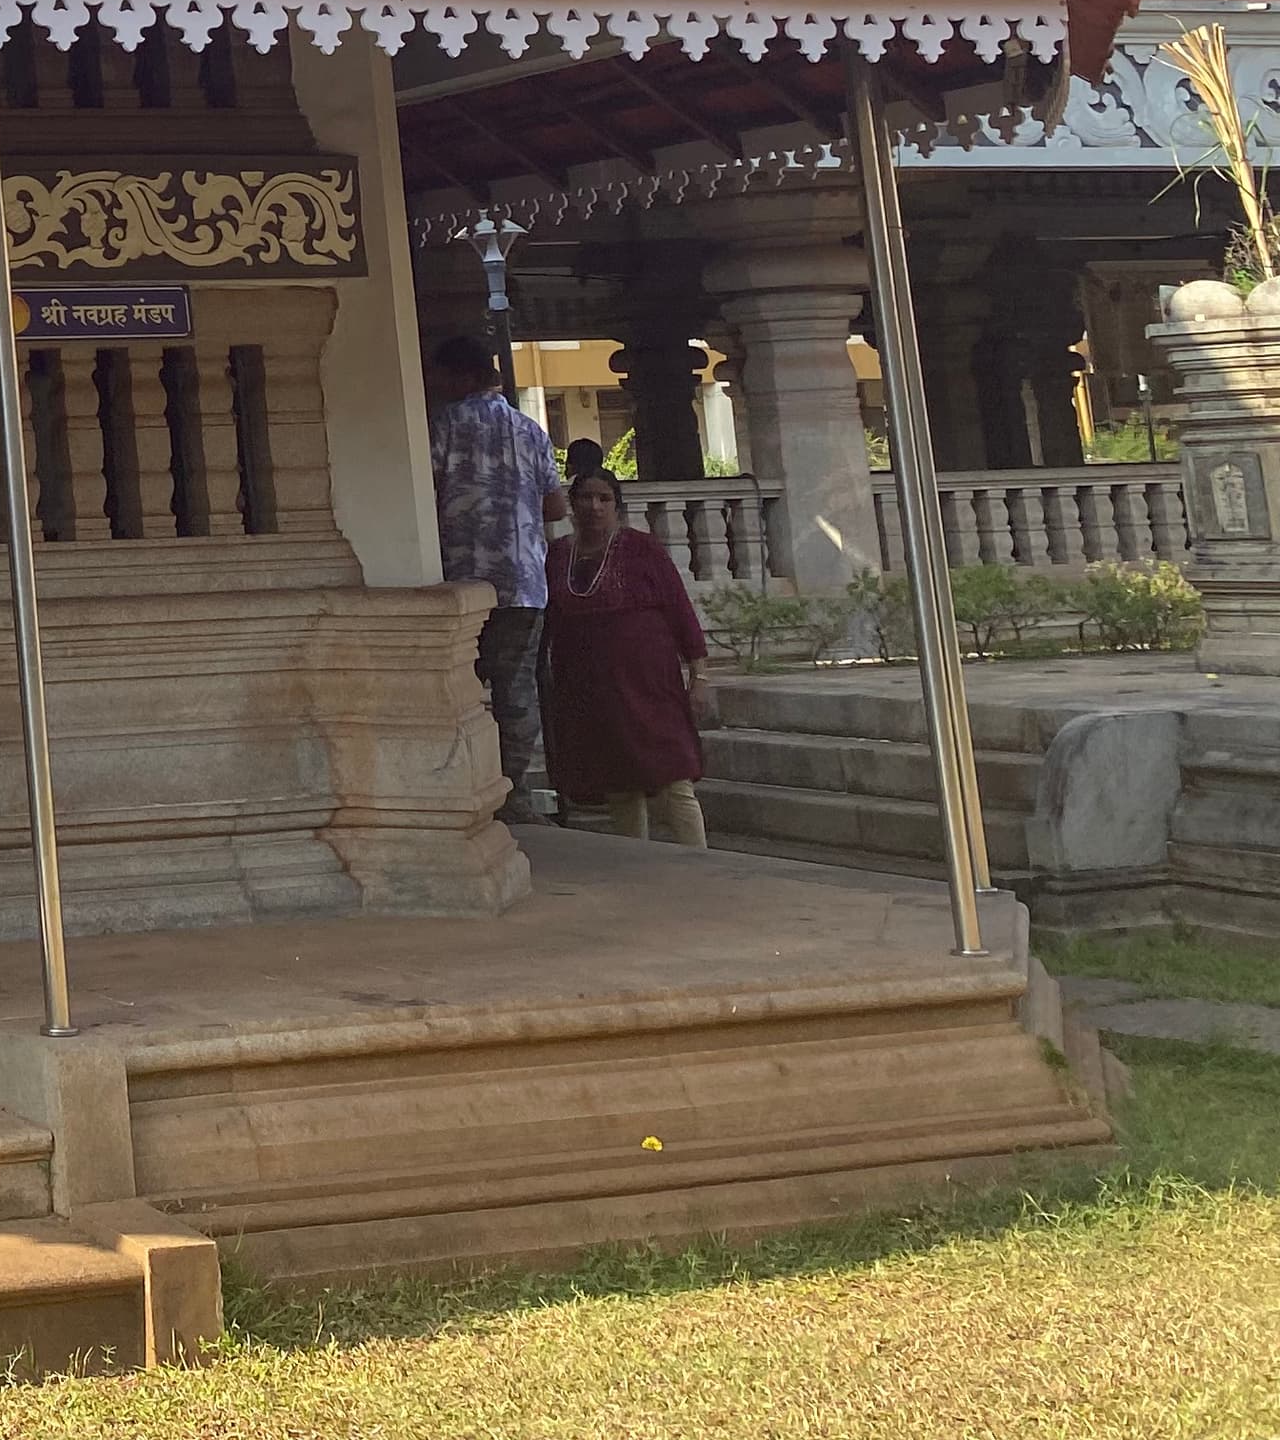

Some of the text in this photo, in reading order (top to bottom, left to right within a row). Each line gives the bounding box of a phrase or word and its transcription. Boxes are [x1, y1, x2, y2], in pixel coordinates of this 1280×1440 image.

[41, 298, 175, 327] श्री नवग्रह मंडप
